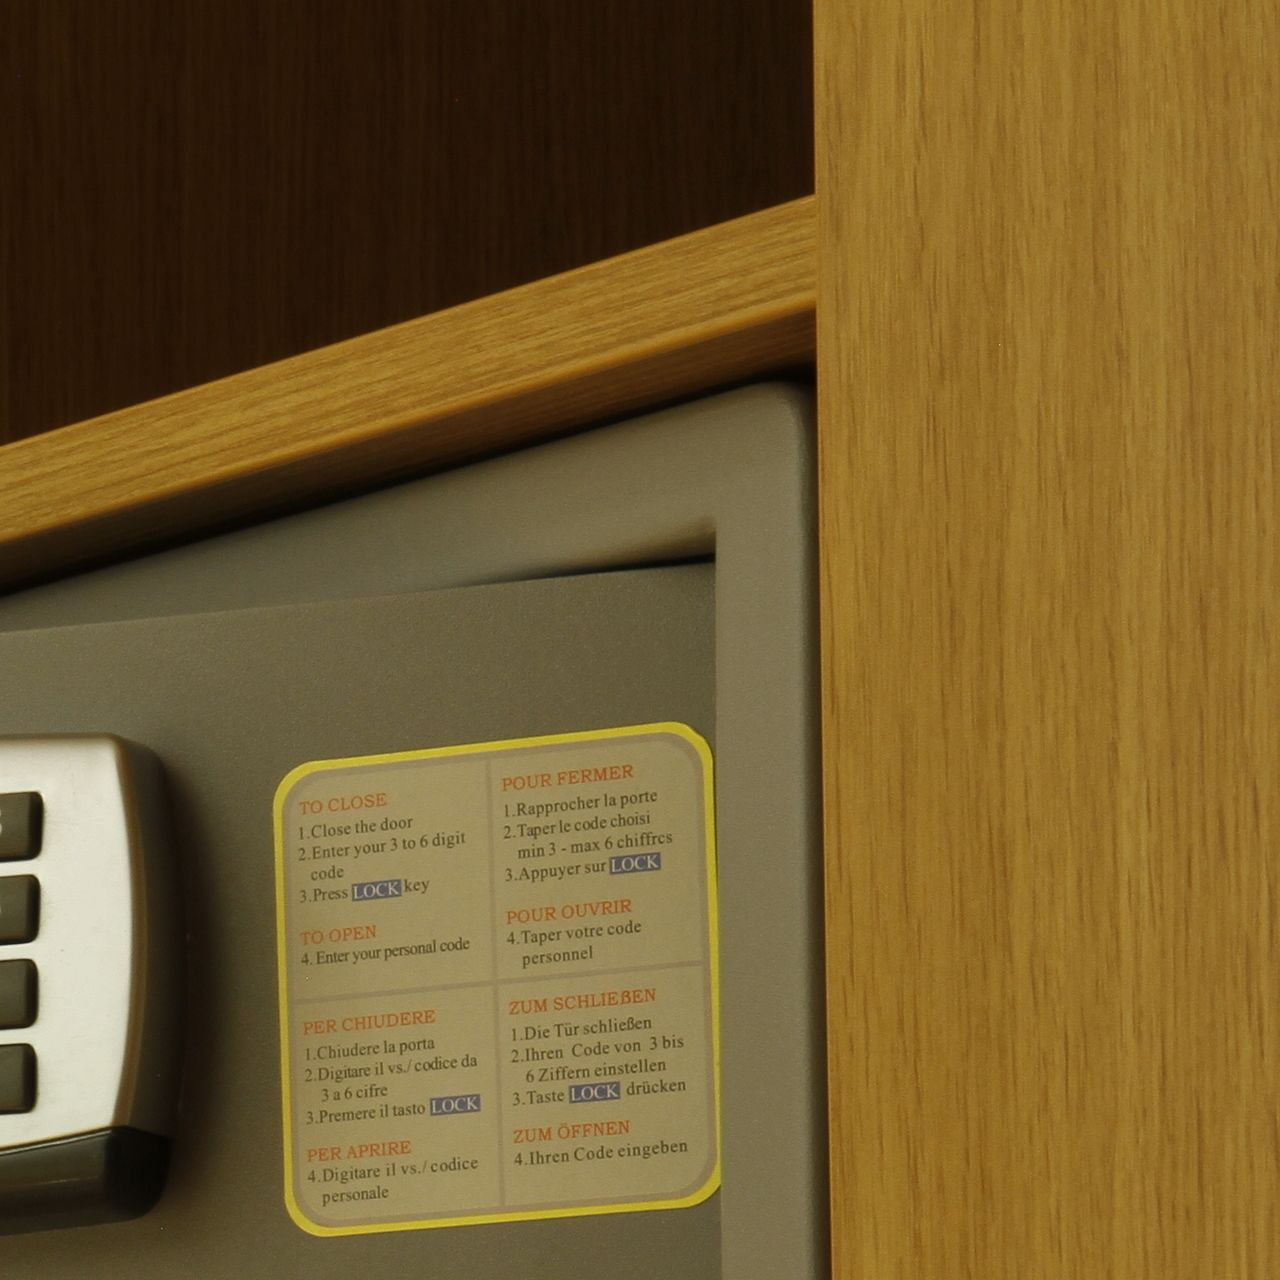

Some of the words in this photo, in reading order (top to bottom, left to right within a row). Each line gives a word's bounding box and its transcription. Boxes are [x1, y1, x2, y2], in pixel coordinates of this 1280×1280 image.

[502, 774, 552, 791] POUR
[557, 765, 634, 785] FERMER
[300, 801, 322, 814] TO
[328, 793, 387, 812] CLOSE
[604, 793, 617, 807] la
[621, 791, 658, 808] porte
[355, 820, 376, 833] the
[380, 817, 413, 831] door
[559, 819, 571, 833] le
[575, 817, 607, 831] code
[611, 811, 651, 828] choisi
[354, 841, 386, 859] your
[390, 838, 398, 851] 3
[402, 838, 416, 849] to
[420, 836, 428, 847] 6
[432, 831, 466, 849] digit
[518, 844, 545, 859] min
[548, 842, 556, 856] 3
[571, 840, 600, 853] max
[605, 836, 613, 849] 6
[617, 831, 673, 848] chiffres
[311, 866, 344, 881] code
[585, 861, 607, 873] sur
[611, 855, 659, 872] LOCK
[353, 881, 399, 899] LOCK
[404, 879, 430, 894] key
[507, 907, 556, 924] POUR
[561, 900, 632, 919] OUVRIR
[300, 932, 323, 945] TO
[329, 925, 377, 943] OPEN
[566, 925, 603, 939] votre
[607, 920, 642, 934] code
[301, 954, 313, 966] 4.
[316, 951, 350, 965] Enter
[353, 948, 381, 964] your
[385, 940, 436, 961] personal
[440, 937, 470, 952] code
[522, 946, 593, 969] personnel
[509, 998, 547, 1015] ZUM
[304, 1020, 337, 1035] PER
[342, 1010, 436, 1031] CHIUDERE
[554, 1022, 579, 1037] Tür
[583, 1017, 652, 1035] schließen
[384, 1041, 396, 1053] la
[400, 1039, 435, 1056] porta
[572, 1042, 610, 1057] Code
[614, 1041, 641, 1053] von
[649, 1037, 657, 1050] 3
[662, 1035, 684, 1049] bis
[375, 1062, 384, 1076] il
[414, 1057, 457, 1072] codice
[461, 1054, 477, 1068] da
[526, 1070, 534, 1083] 6
[538, 1065, 590, 1082] Ziffern
[594, 1059, 666, 1077] einstellen
[322, 1089, 329, 1101] 3
[333, 1091, 341, 1100] a
[344, 1088, 353, 1099] 6
[356, 1084, 388, 1098] cifre
[571, 1084, 618, 1101] LOCK
[626, 1079, 686, 1096] drücken
[380, 1105, 389, 1118] il
[393, 1103, 425, 1116] tasto
[432, 1097, 478, 1113] LOCK
[513, 1127, 552, 1144] ZUM
[558, 1120, 631, 1139] ÖFFNEN
[308, 1147, 342, 1162] PER
[346, 1141, 412, 1159] APRIRE
[574, 1146, 613, 1161] Code
[618, 1140, 688, 1159] eingeben
[386, 1164, 396, 1177] il
[431, 1156, 478, 1172] codice
[322, 1186, 389, 1206] personale
